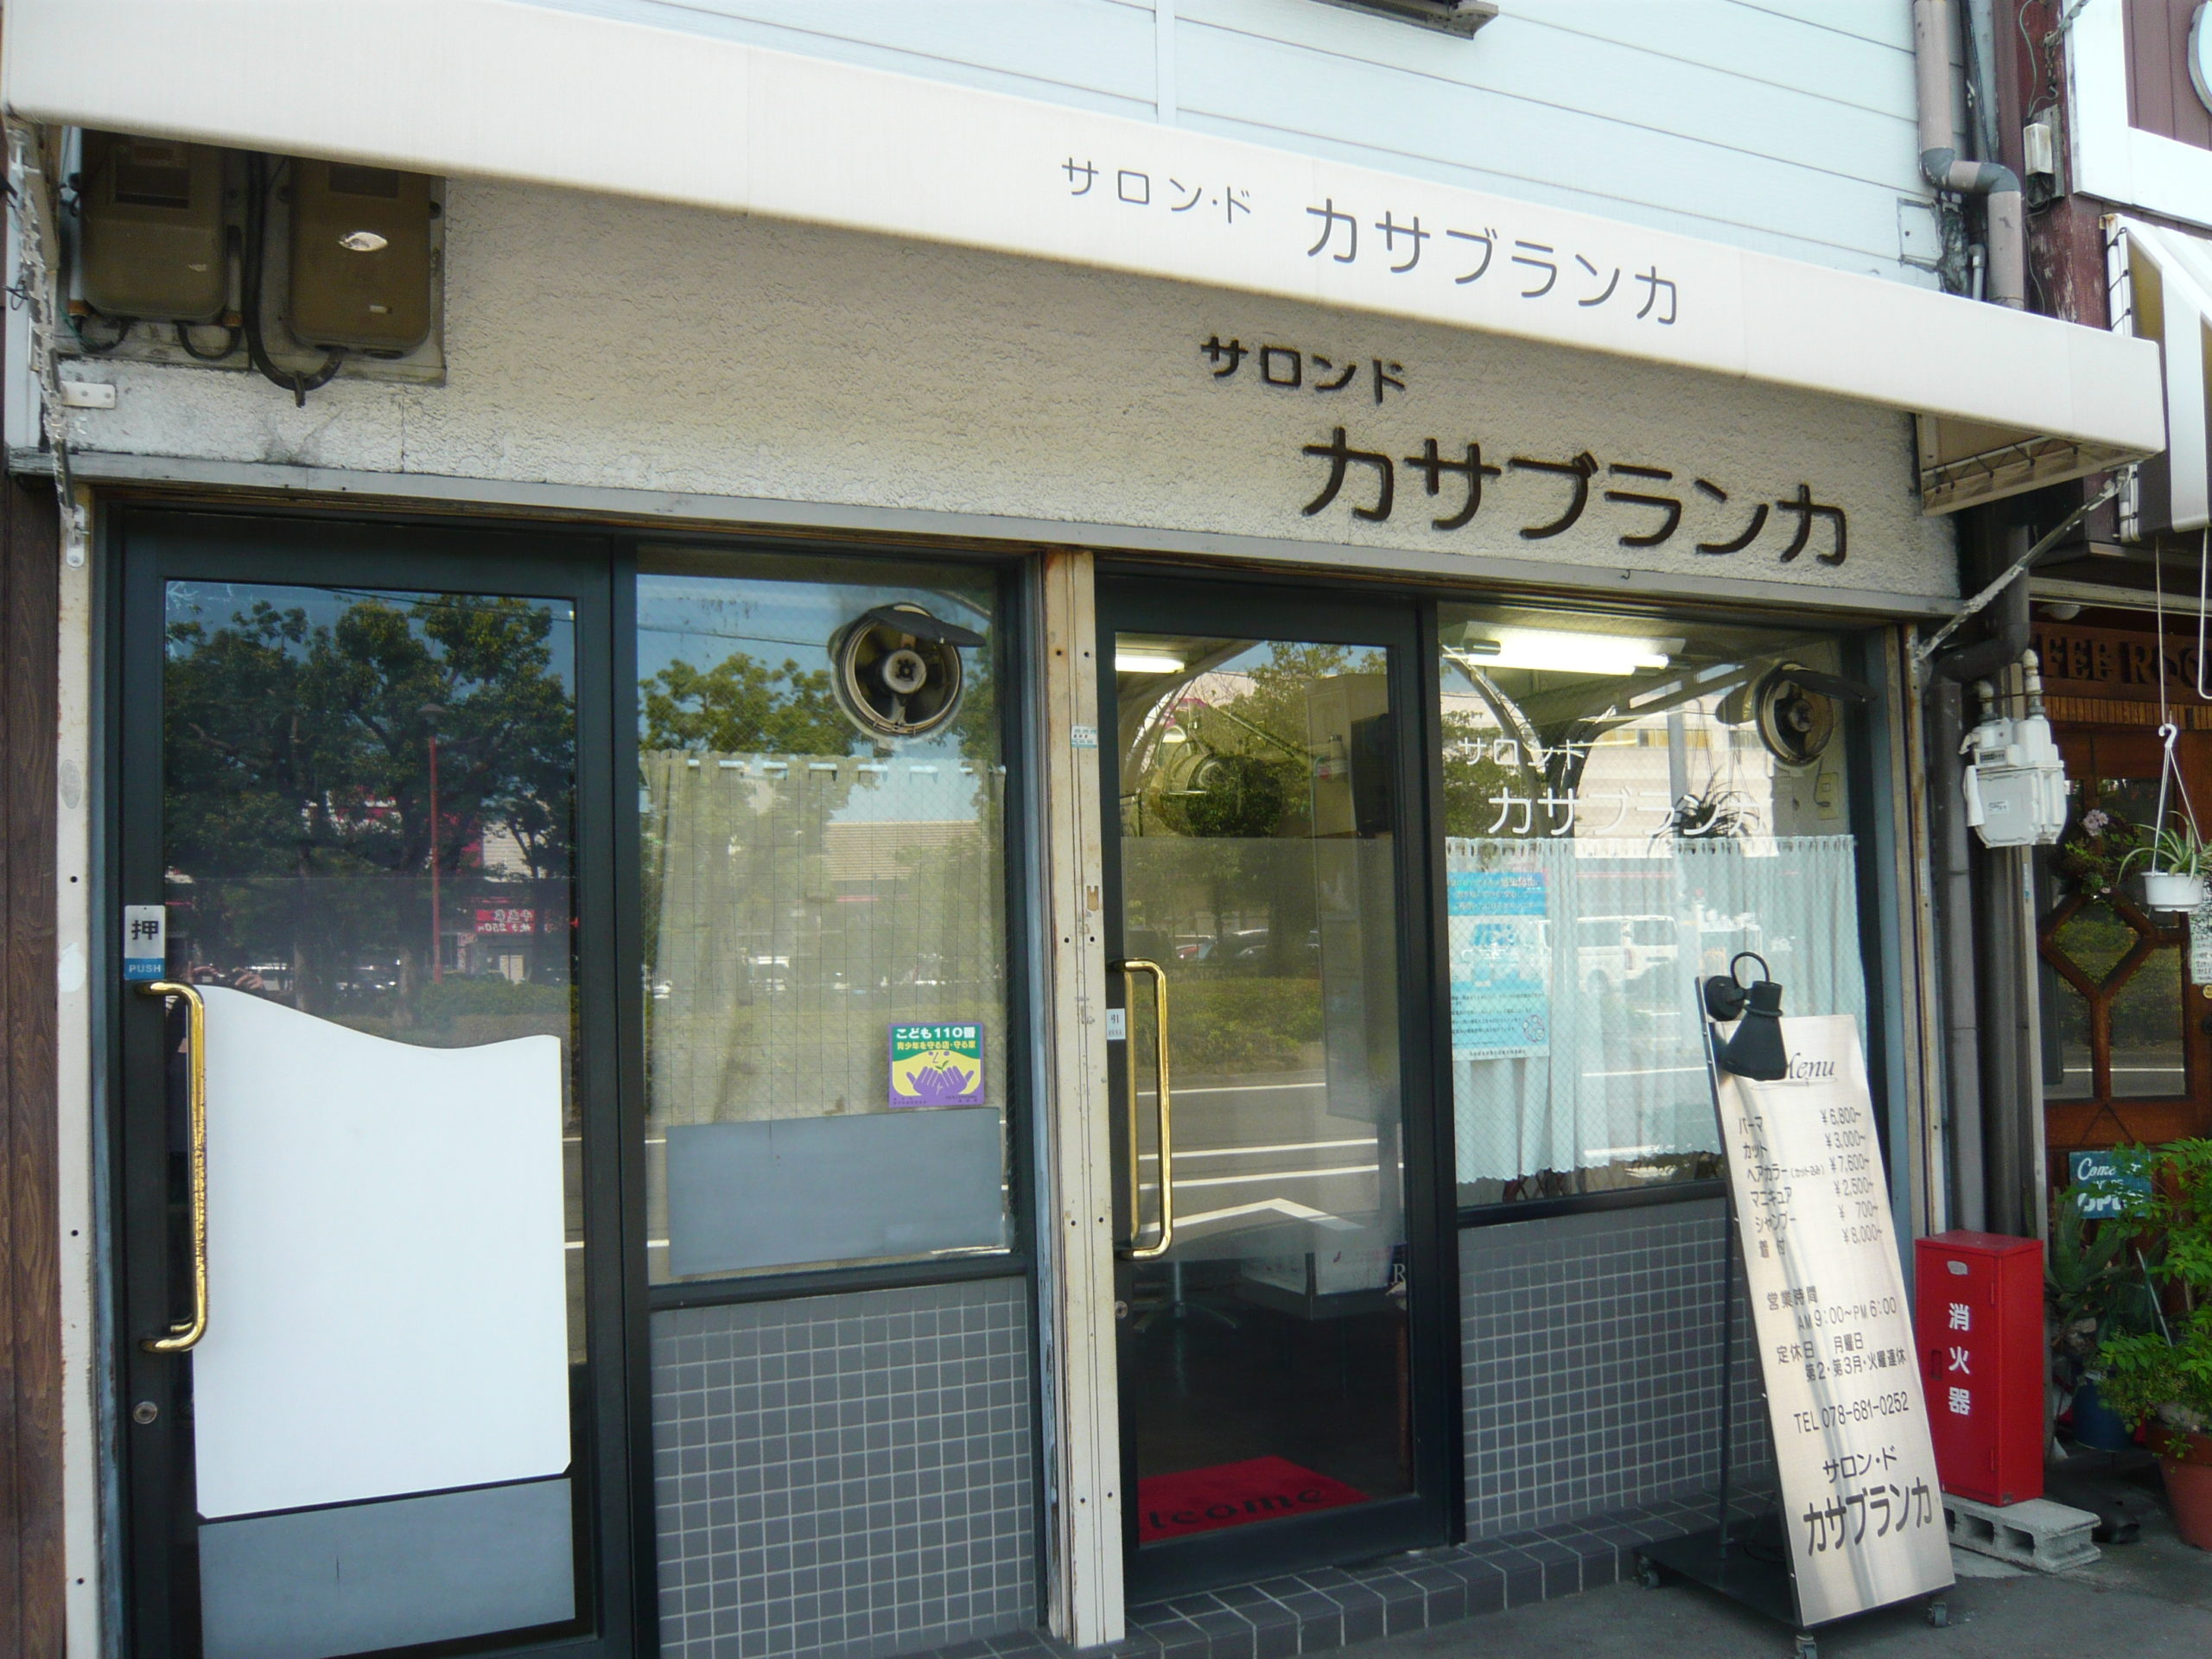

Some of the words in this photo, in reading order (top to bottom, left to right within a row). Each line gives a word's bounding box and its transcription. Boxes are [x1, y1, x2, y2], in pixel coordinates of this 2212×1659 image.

[1306, 198, 1677, 326] カサブランカ
[1201, 335, 1407, 404] サロンド
[1300, 427, 1848, 567] カサブランカ
[2120, 641, 2212, 690] ROO
[1488, 787, 1764, 836] カサブランカ
[131, 919, 159, 941] 押
[129, 963, 162, 973] PUSH
[1738, 1116, 1764, 1135] パーマ
[1743, 1140, 1768, 1160] カット
[1747, 1163, 1789, 1183] ヘアカラー
[1751, 1186, 1792, 1208] マニキュア
[1755, 1211, 1796, 1234] シャンプー
[1767, 1285, 1819, 1312] 営業時間
[1777, 1341, 1815, 1365] 定休日
[1834, 1332, 1864, 1355] 月曜日
[1793, 1410, 1820, 1434] TEL
[1821, 1390, 1910, 1428] 078-681-0252
[1802, 1476, 1933, 1557] カサブランカ
